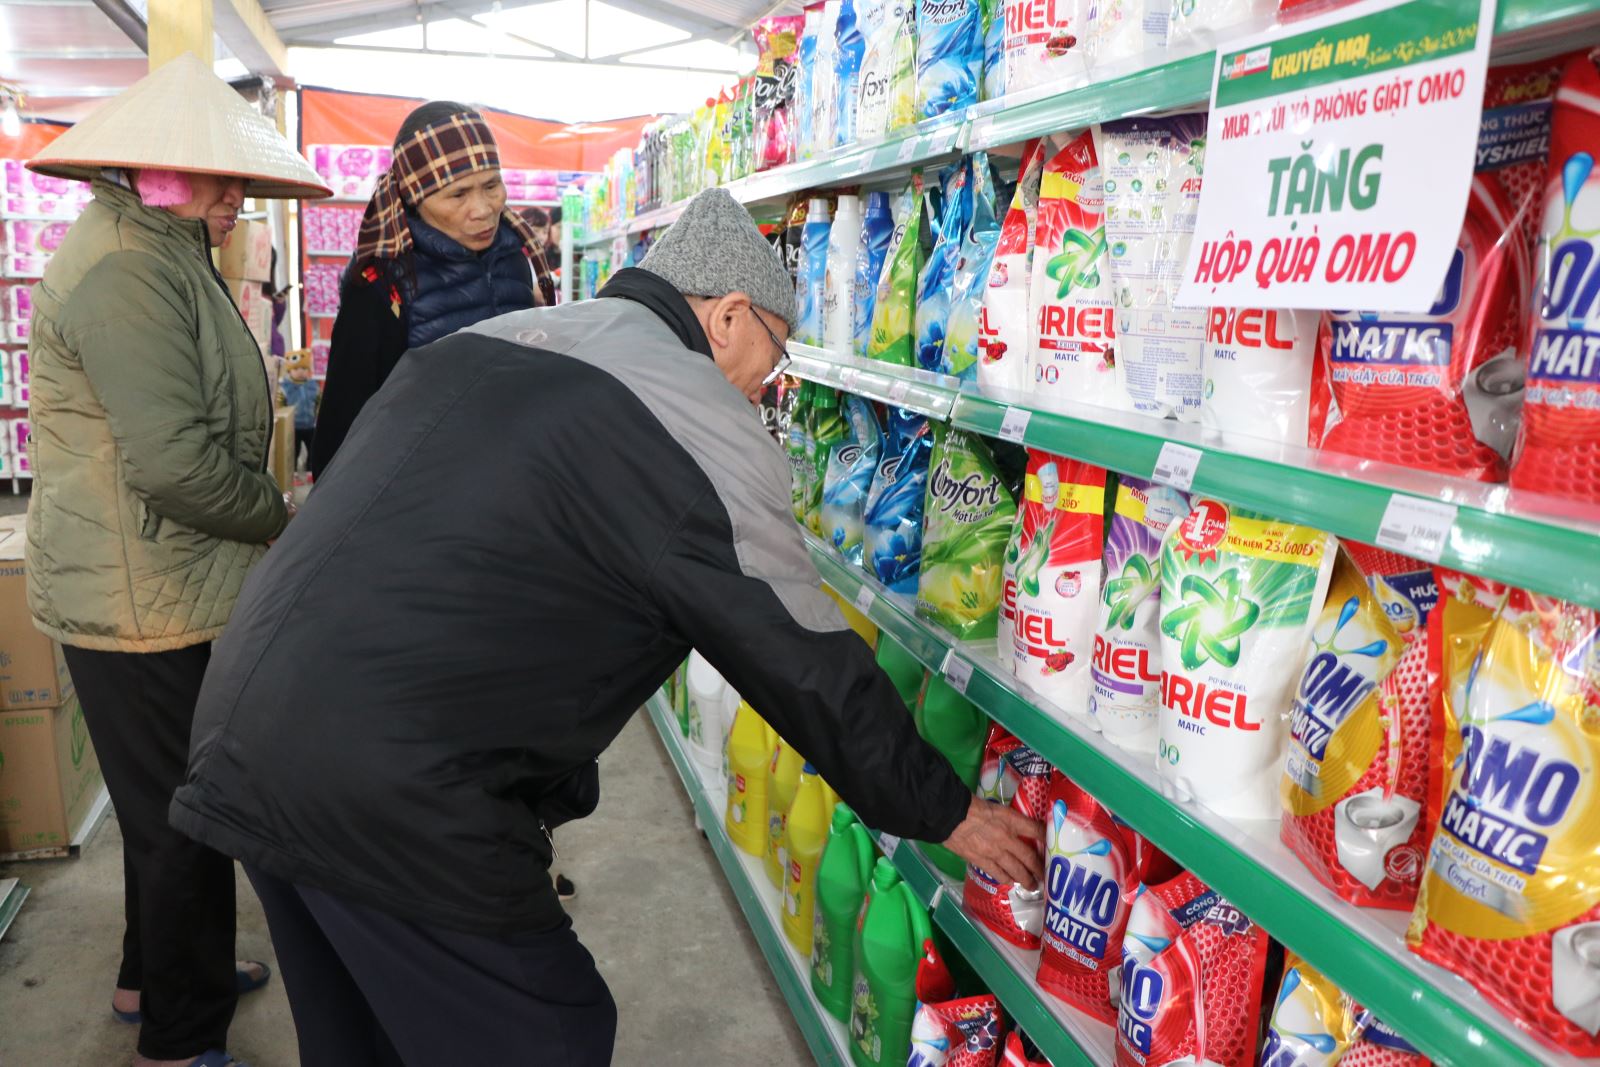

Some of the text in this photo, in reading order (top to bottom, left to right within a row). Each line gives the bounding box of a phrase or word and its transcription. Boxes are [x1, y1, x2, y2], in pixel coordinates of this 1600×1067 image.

[1271, 38, 1333, 80] KHUYẾN
[1334, 34, 1370, 66] MẠI
[1221, 112, 1249, 140] MUA
[1313, 88, 1368, 124] PHÒNG
[1418, 68, 1465, 105] OMO
[1267, 141, 1384, 232] TẶNG
[1194, 231, 1252, 294] HỘP
[1256, 226, 1321, 290] QUÀ
[1325, 231, 1417, 284] OMO
[1054, 352, 1080, 362] MATIC
[1214, 349, 1237, 361] MATIC
[1185, 505, 1208, 542] 1
[1227, 535, 1242, 547] TIẾT
[1243, 538, 1263, 550] KIỆM
[1095, 685, 1116, 701] MATIC
[1177, 719, 1207, 737] MATIC
[1459, 724, 1580, 827] OMO
[1443, 798, 1537, 866] MATIC
[1047, 855, 1120, 927] OMO
[1447, 863, 1487, 898] Comfort
[1046, 907, 1101, 953] MATIC
